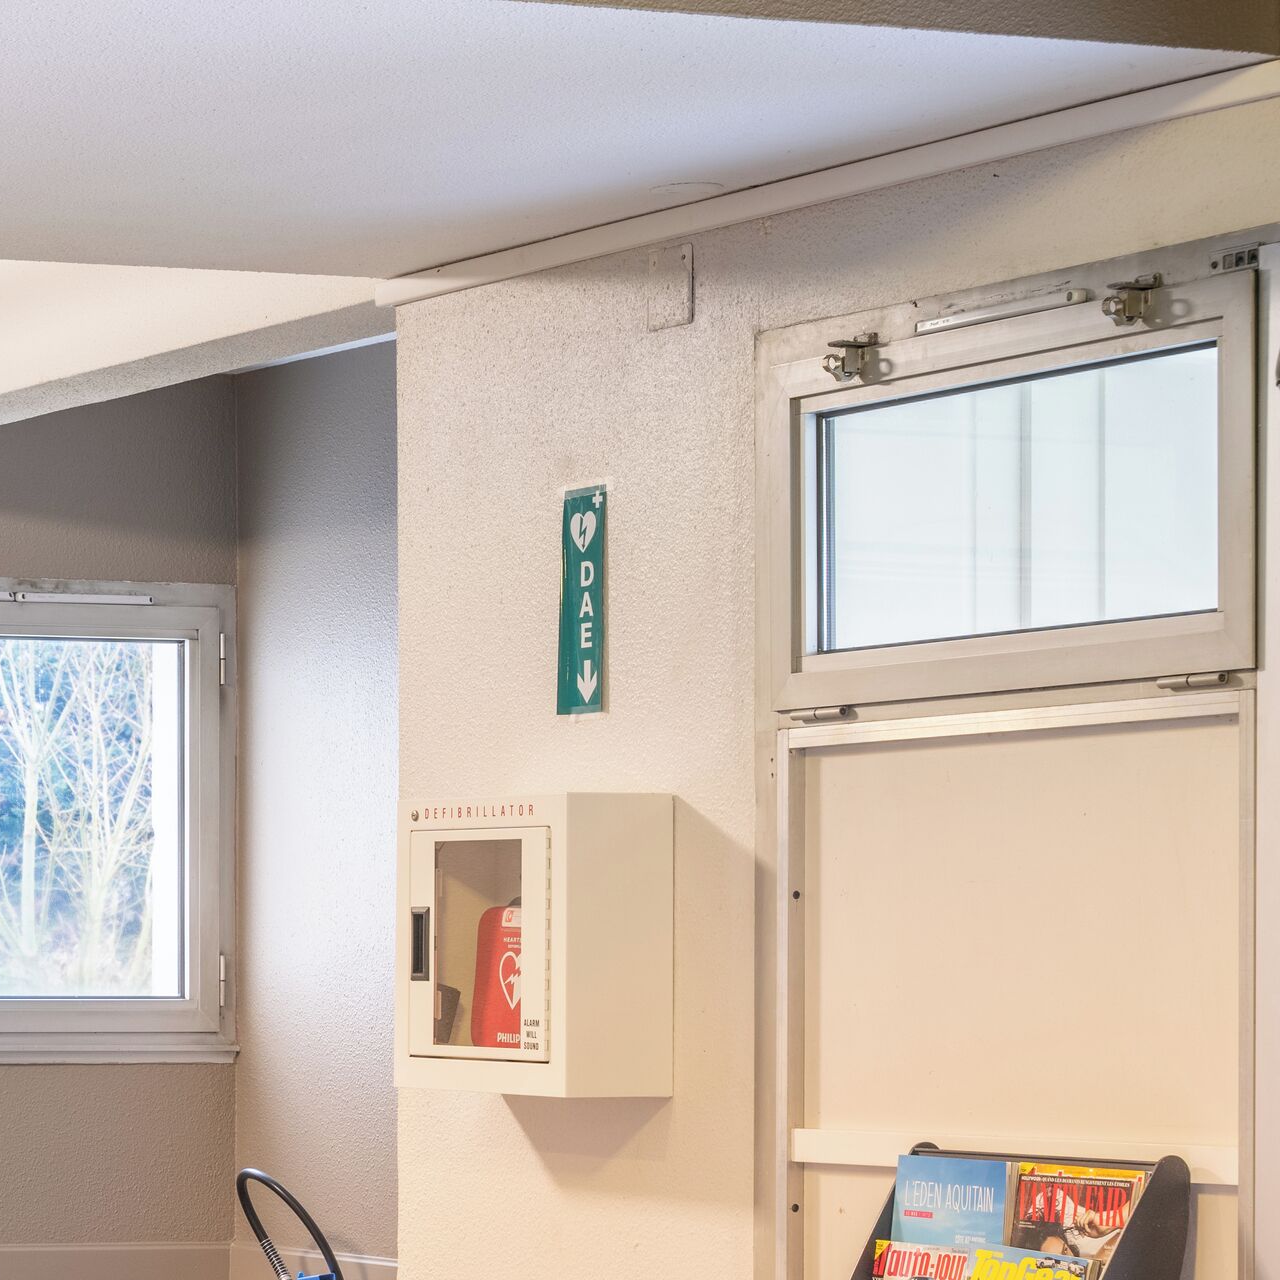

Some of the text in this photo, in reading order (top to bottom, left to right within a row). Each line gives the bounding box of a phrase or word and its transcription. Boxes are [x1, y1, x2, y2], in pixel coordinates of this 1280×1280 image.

[424, 804, 534, 820] DEFIBRILLATOR
[524, 1019, 540, 1027] ALARM
[496, 1032, 521, 1043] PHILIP
[526, 1031, 537, 1039] WILL
[524, 1042, 539, 1050] SOUND
[945, 1183, 994, 1213] AQUITAIN
[1019, 1181, 1127, 1229] VANITY FAIR
